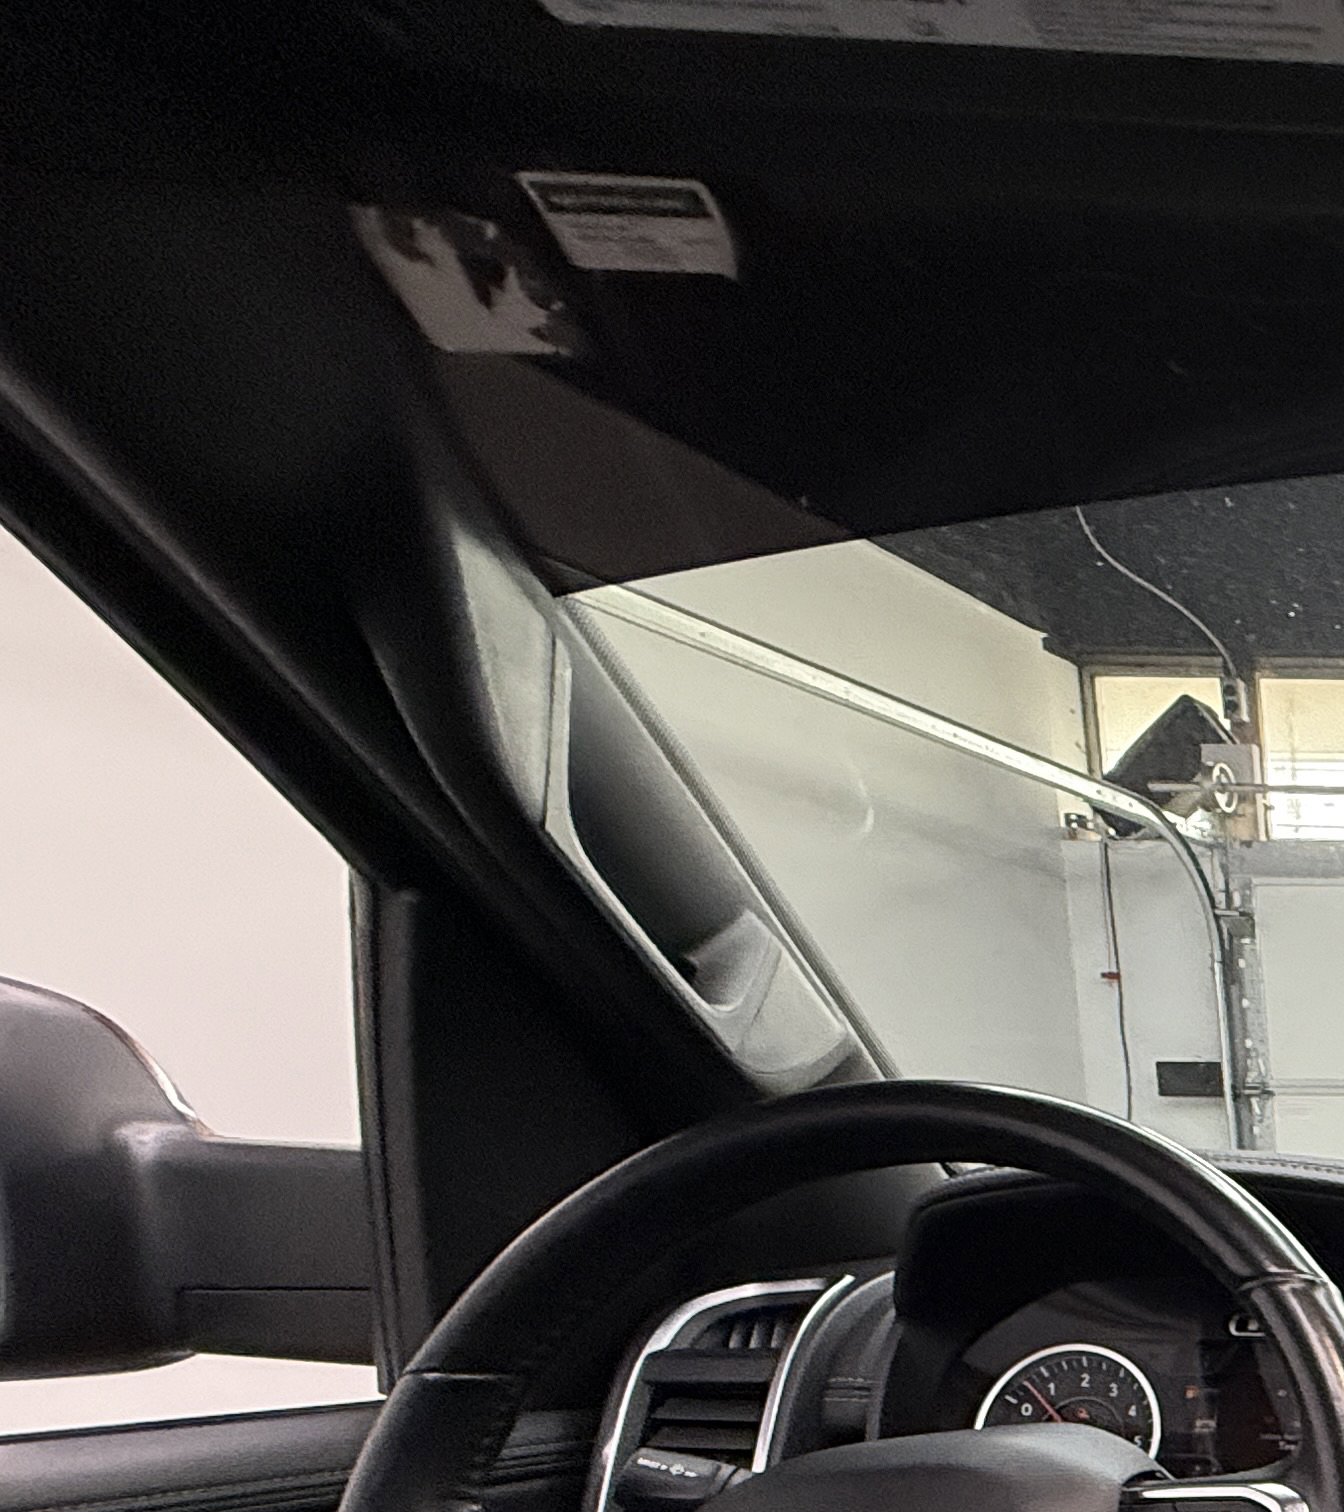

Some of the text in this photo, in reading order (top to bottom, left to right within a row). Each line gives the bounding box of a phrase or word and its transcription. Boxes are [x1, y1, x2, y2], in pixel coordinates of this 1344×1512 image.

[1080, 1373, 1090, 1388] 2
[1048, 1382, 1056, 1396] 1
[1109, 1383, 1119, 1397] 3
[1020, 1402, 1033, 1416] 0
[1128, 1404, 1137, 1418] 4
[1134, 1434, 1143, 1448] 5
